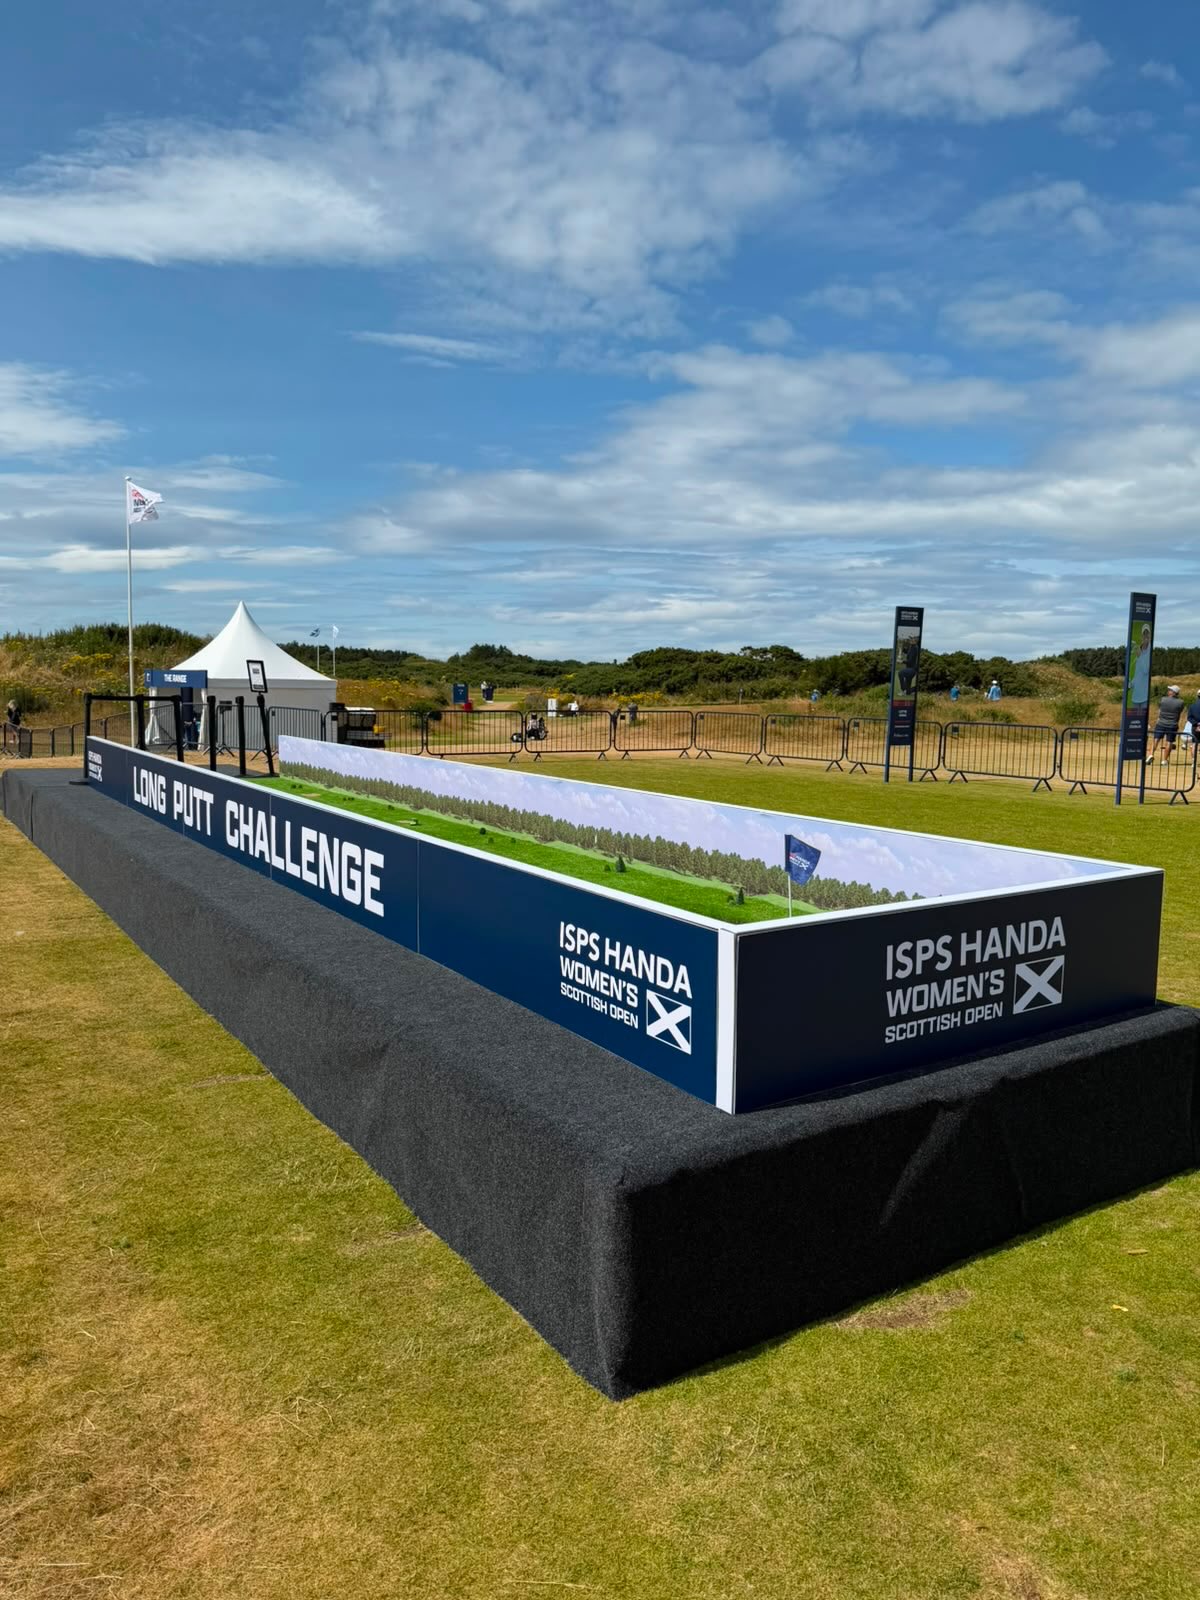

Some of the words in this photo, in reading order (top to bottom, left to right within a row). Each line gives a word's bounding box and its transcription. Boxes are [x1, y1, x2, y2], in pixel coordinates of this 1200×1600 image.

[133, 766, 167, 815] LONG
[173, 780, 214, 836] PUTT
[225, 799, 385, 917] CHALLENGE
[559, 921, 600, 961] ISPS
[604, 937, 693, 999] HANDA
[886, 934, 953, 981] ISPS
[960, 916, 1067, 967] HANDA
[559, 954, 638, 1008] WOMEN'S
[560, 981, 608, 1015] SCOTTISH
[609, 1003, 639, 1029] OPEN
[886, 968, 1005, 1018] WOMEN'S
[884, 1011, 961, 1044] SCOTTISH
[964, 1001, 1004, 1025] OPEN
